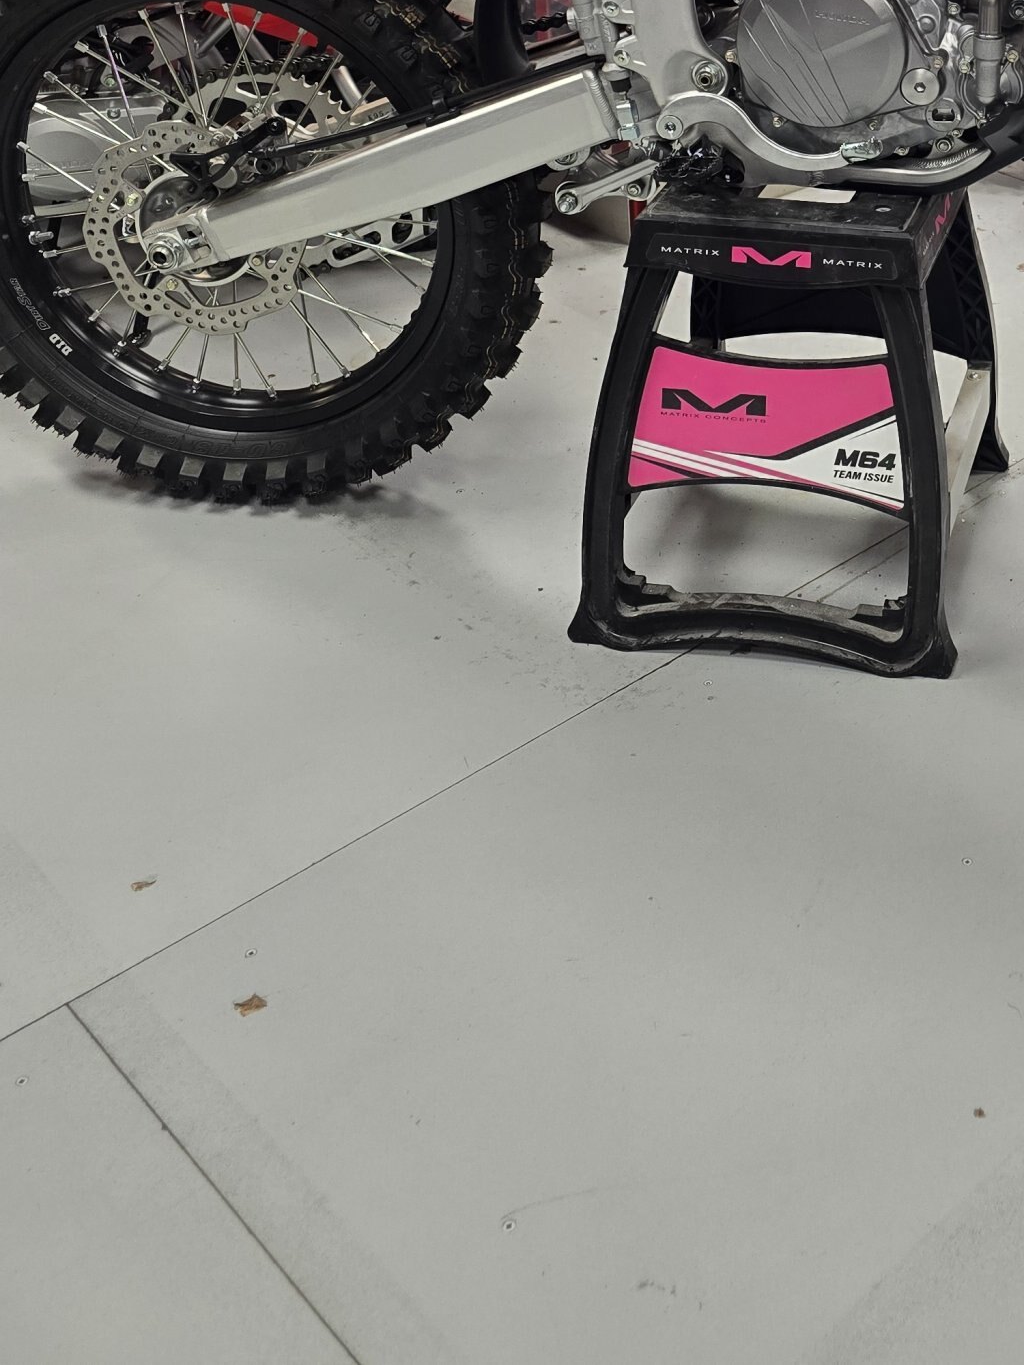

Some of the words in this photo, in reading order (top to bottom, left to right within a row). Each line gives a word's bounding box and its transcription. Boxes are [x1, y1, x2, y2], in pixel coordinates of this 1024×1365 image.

[660, 245, 720, 256] MATRIX
[822, 258, 883, 270] MATRIX
[660, 411, 700, 419] MATRIX
[704, 414, 767, 424] CONCEPTS
[833, 448, 897, 471] M64
[833, 469, 863, 481] TEAM
[863, 472, 894, 484] ISSUE
